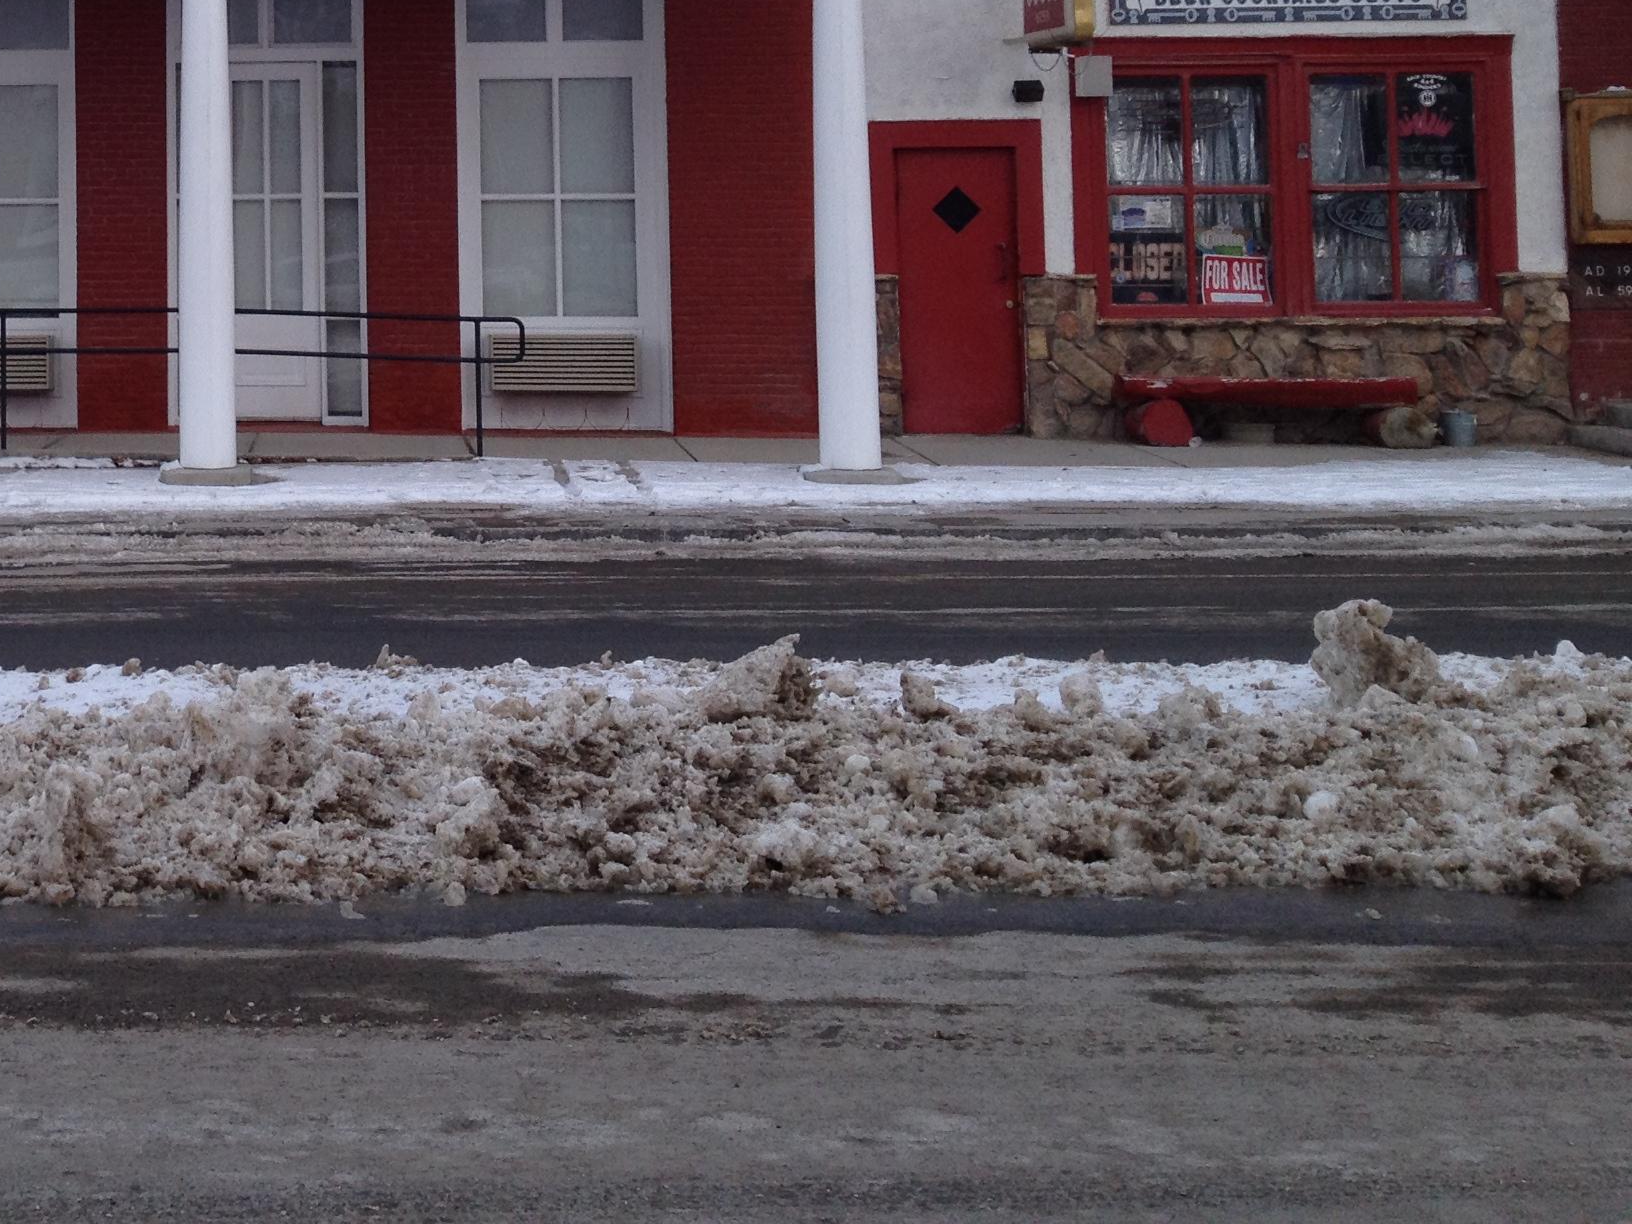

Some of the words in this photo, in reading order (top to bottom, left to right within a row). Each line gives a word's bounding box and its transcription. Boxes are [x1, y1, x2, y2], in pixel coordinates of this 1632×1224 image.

[1205, 259, 1228, 290] FOR
[1232, 261, 1265, 291] SALE
[1584, 265, 1605, 277] AD
[1585, 286, 1604, 297] AL
